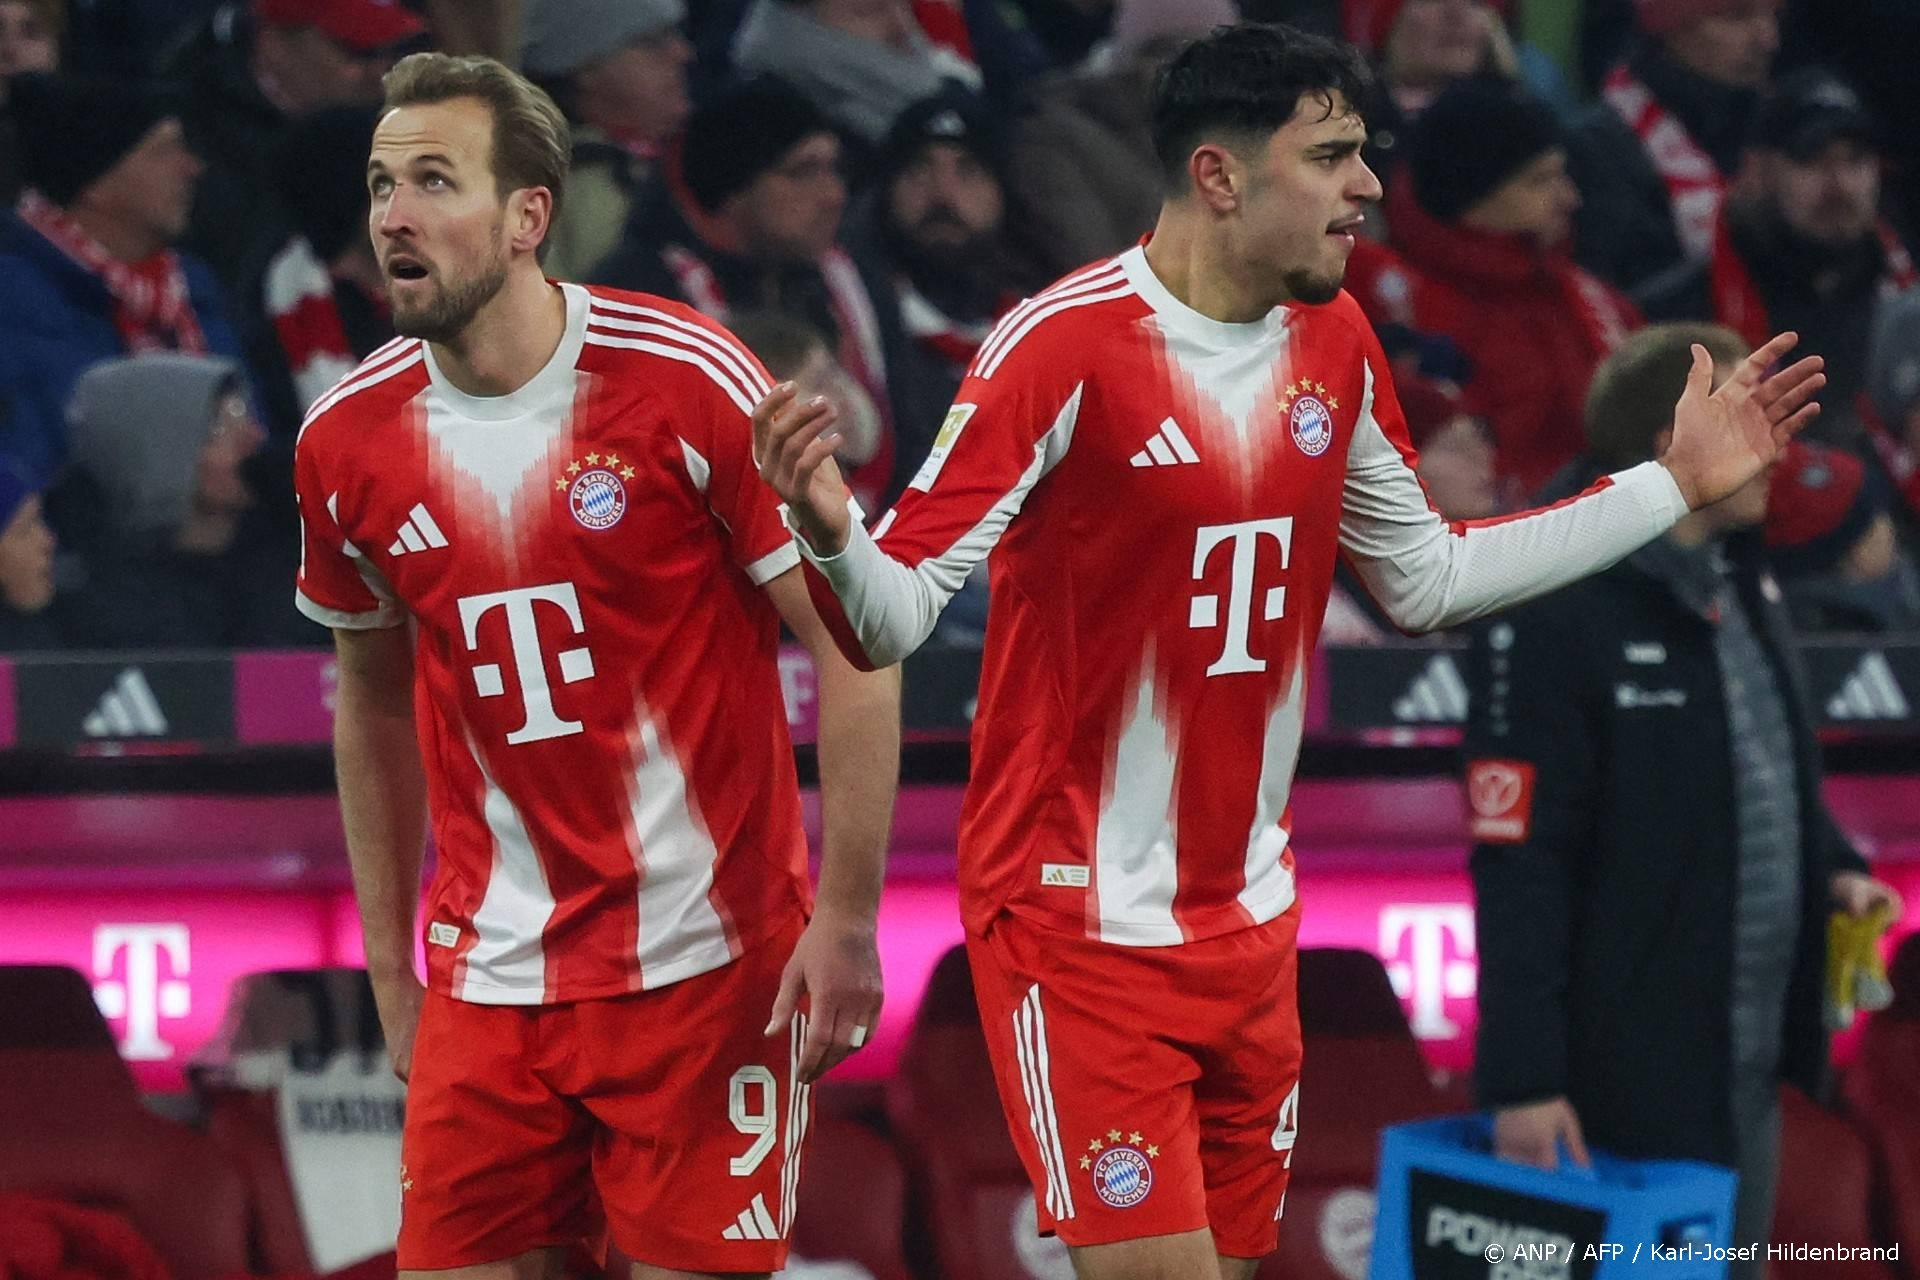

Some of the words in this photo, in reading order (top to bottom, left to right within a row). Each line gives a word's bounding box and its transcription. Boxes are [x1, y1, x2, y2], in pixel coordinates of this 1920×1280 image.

[1300, 400, 1327, 422] BAYERN
[574, 485, 585, 500] FC
[582, 474, 620, 493] BAYERN
[1189, 516, 1293, 677] T
[457, 581, 595, 745] T
[92, 924, 191, 1060] T
[1379, 904, 1477, 1041] T
[728, 1065, 777, 1176] 9
[1097, 1163, 1107, 1178] FC
[1105, 1152, 1146, 1170] BAYERN
